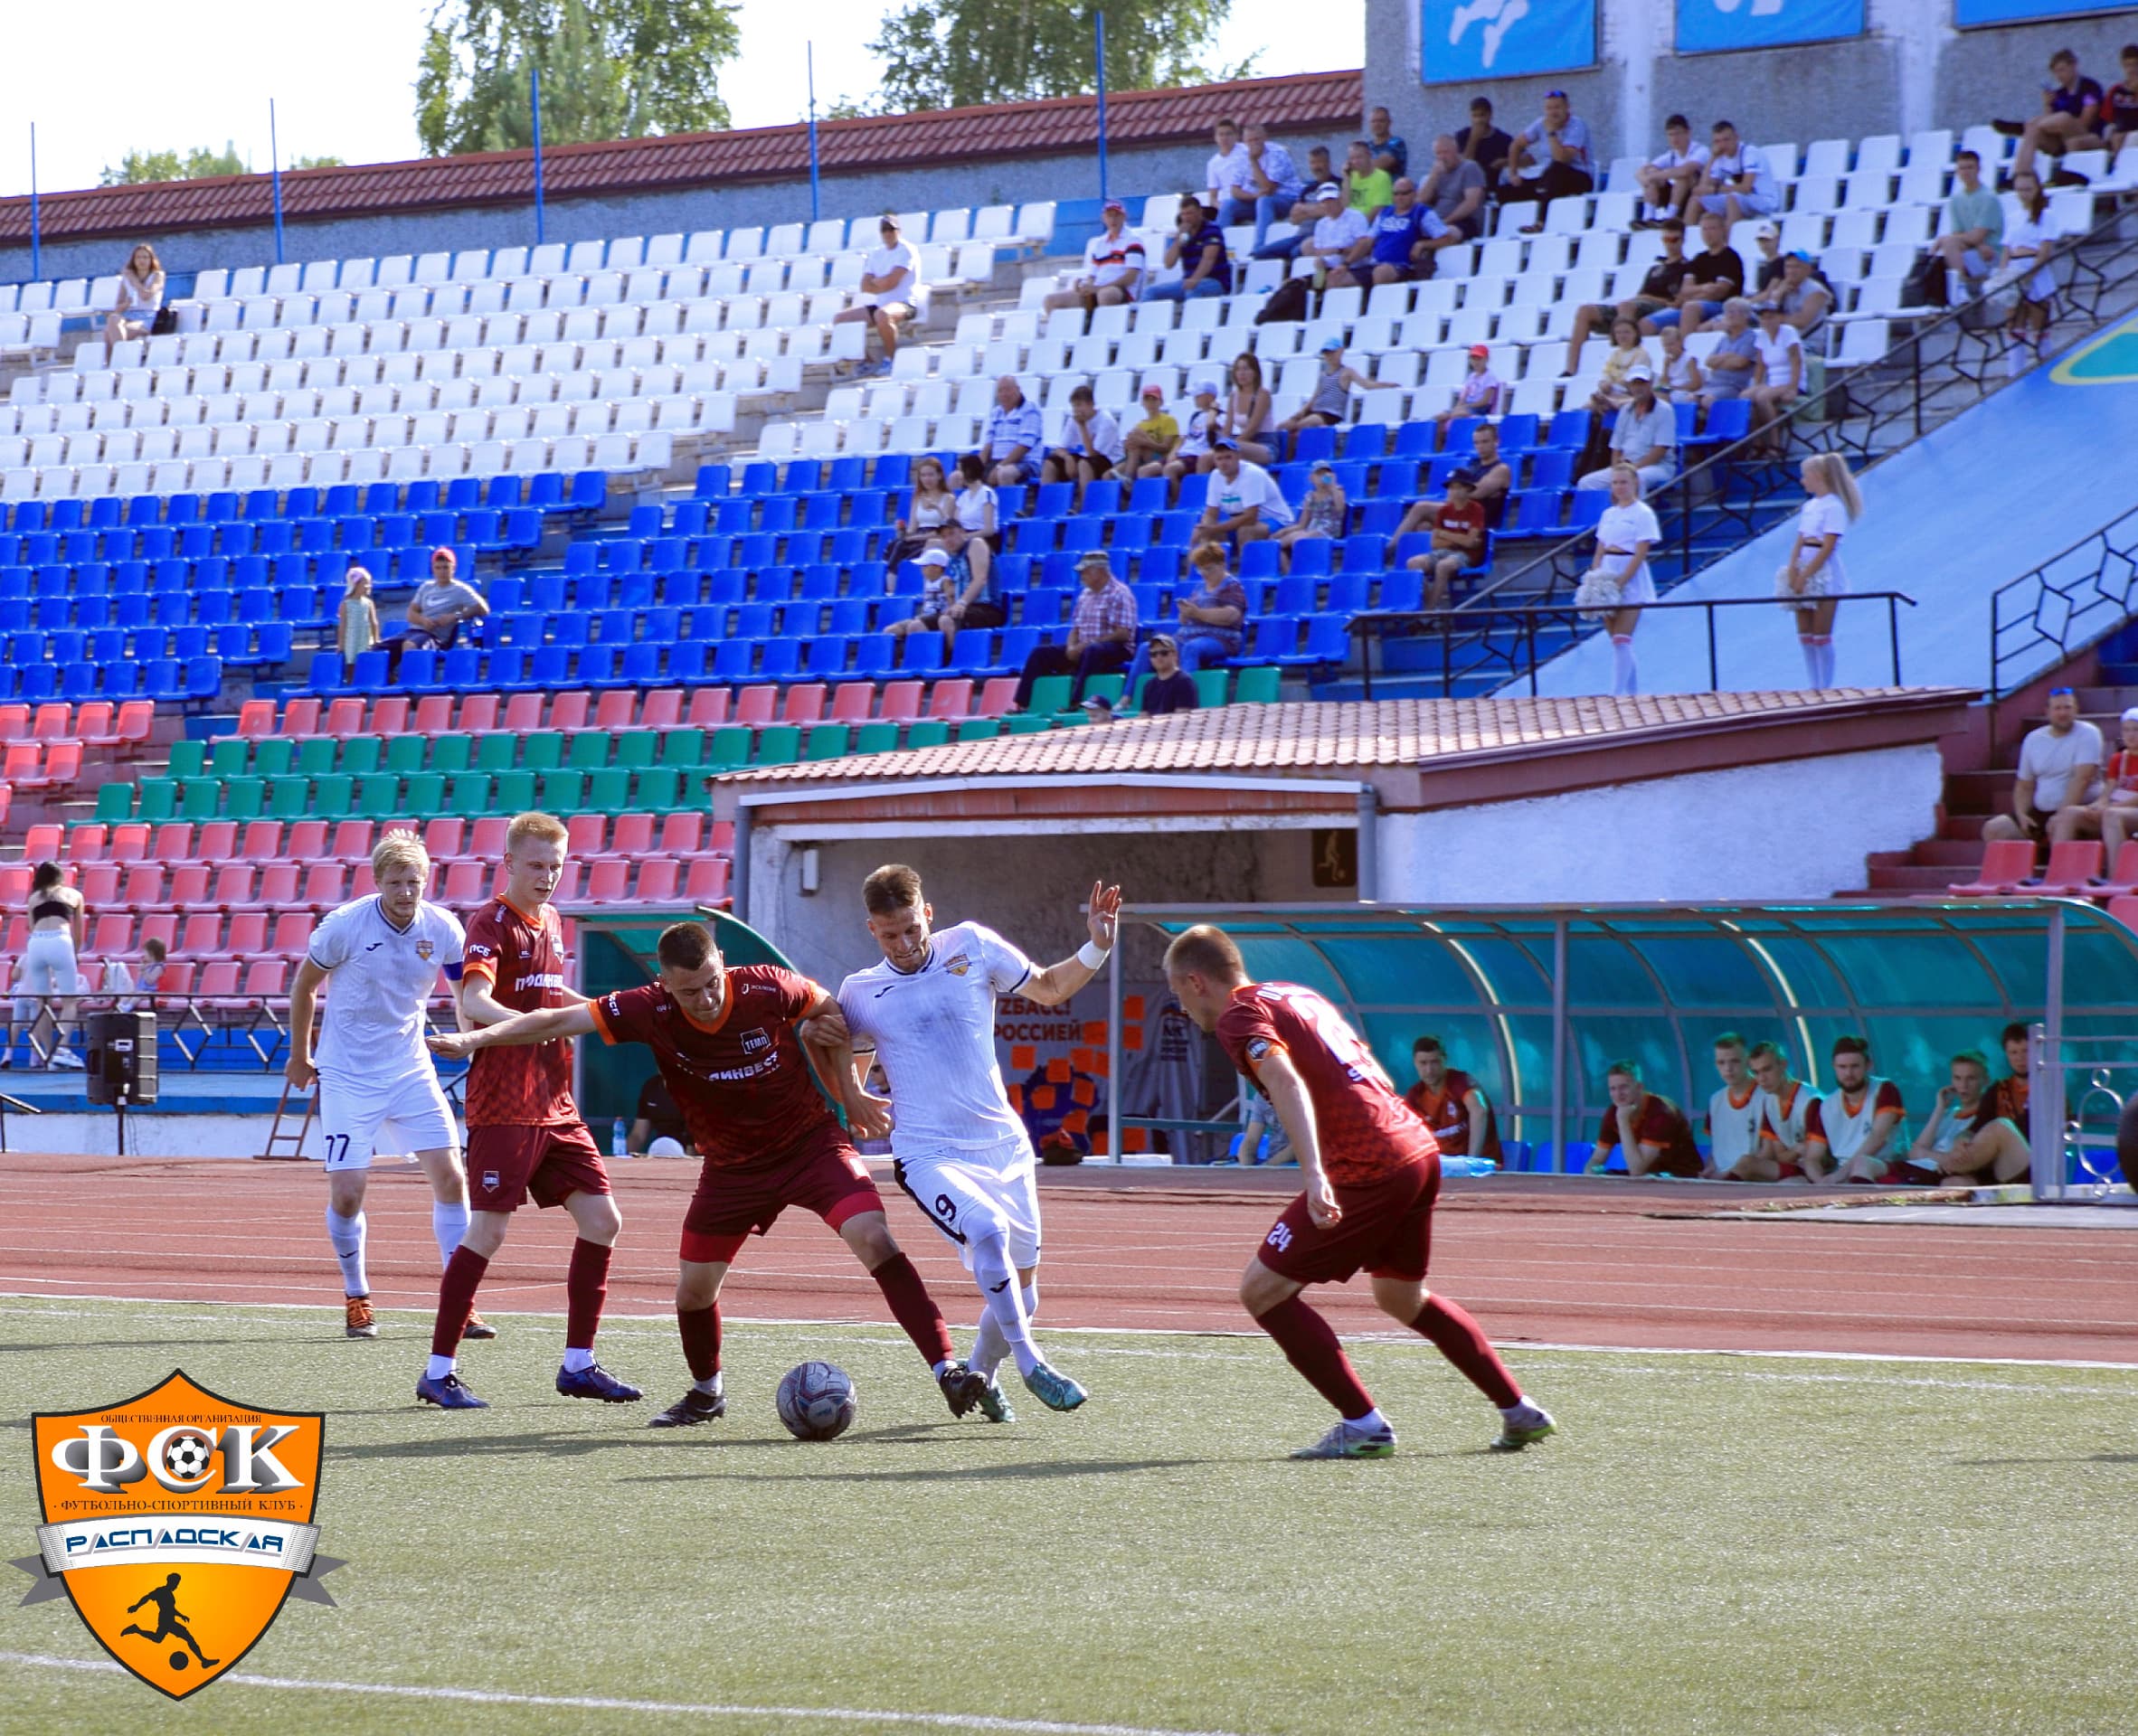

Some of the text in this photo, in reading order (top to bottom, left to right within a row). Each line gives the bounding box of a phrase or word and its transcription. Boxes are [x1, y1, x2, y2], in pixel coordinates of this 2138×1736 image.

[996, 997, 1071, 1015] ZБАСС!
[744, 1036, 768, 1052] ТЕМП
[326, 1134, 350, 1164] 77
[936, 1194, 956, 1222] 9
[1267, 1222, 1292, 1252] 24
